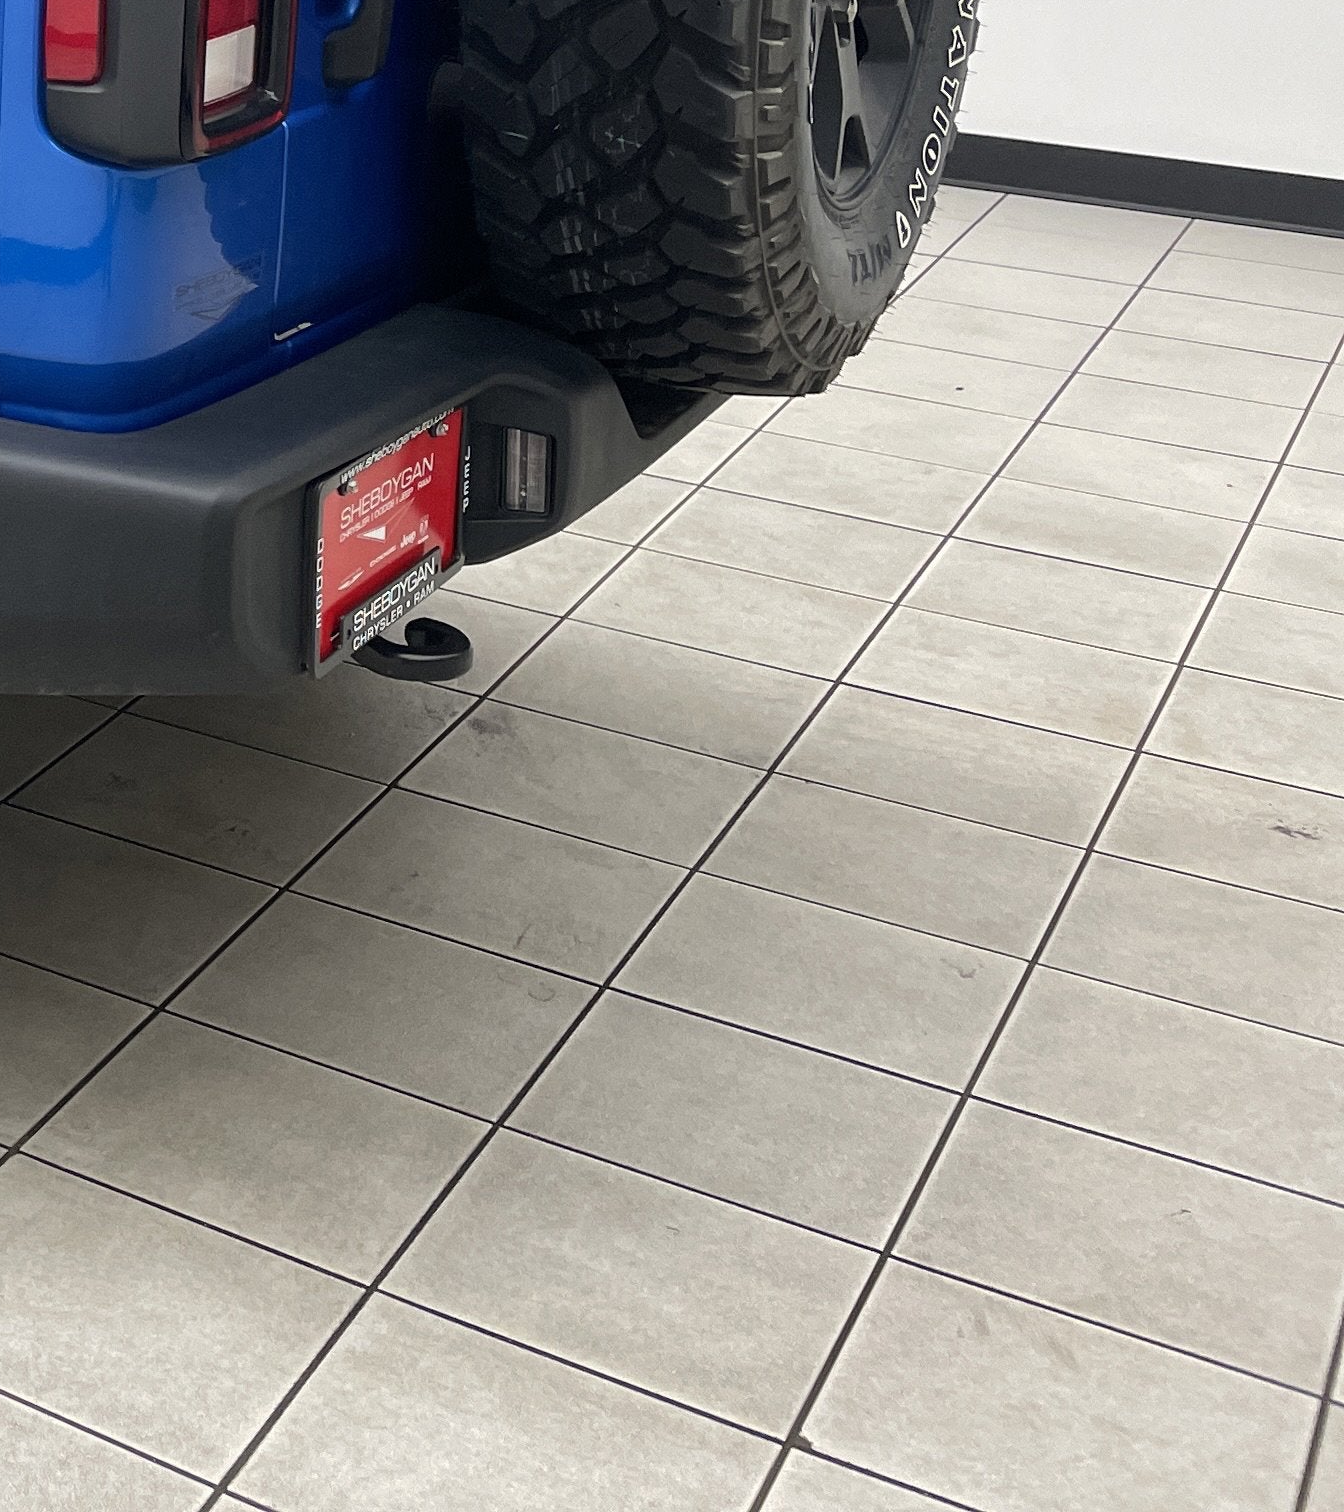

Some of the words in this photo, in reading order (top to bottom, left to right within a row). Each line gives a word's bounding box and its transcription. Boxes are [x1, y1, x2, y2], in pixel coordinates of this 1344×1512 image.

[340, 452, 435, 530] SHEBOYGAN
[462, 445, 471, 513] JEEP
[315, 537, 324, 629] DODGE
[353, 556, 436, 632] SHEBOYGAN
[353, 604, 404, 652] CHRYSLER
[413, 580, 436, 606] RAM
